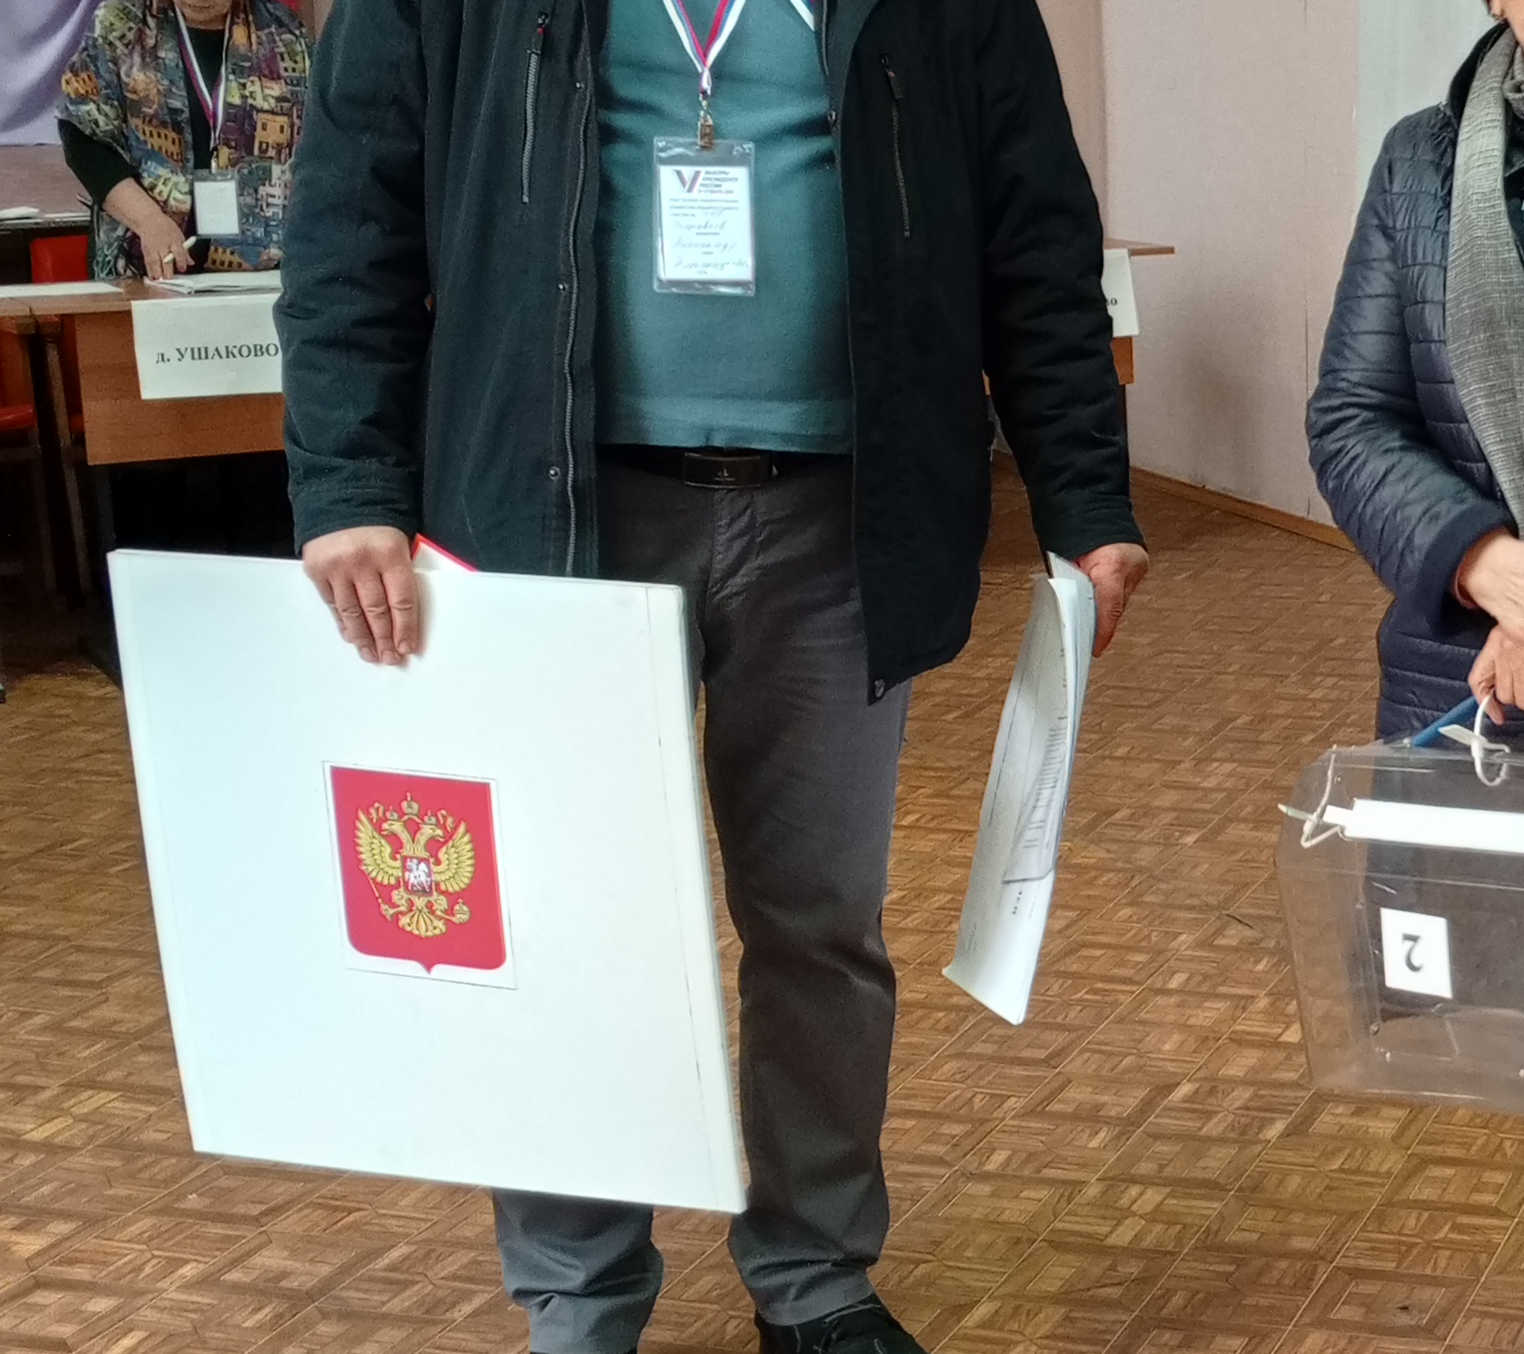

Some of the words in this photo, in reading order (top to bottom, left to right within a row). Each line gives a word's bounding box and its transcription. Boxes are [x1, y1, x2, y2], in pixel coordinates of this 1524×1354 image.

[155, 351, 171, 364] д.
[175, 342, 280, 362] УШАКОВО
[1401, 932, 1424, 973] 2
